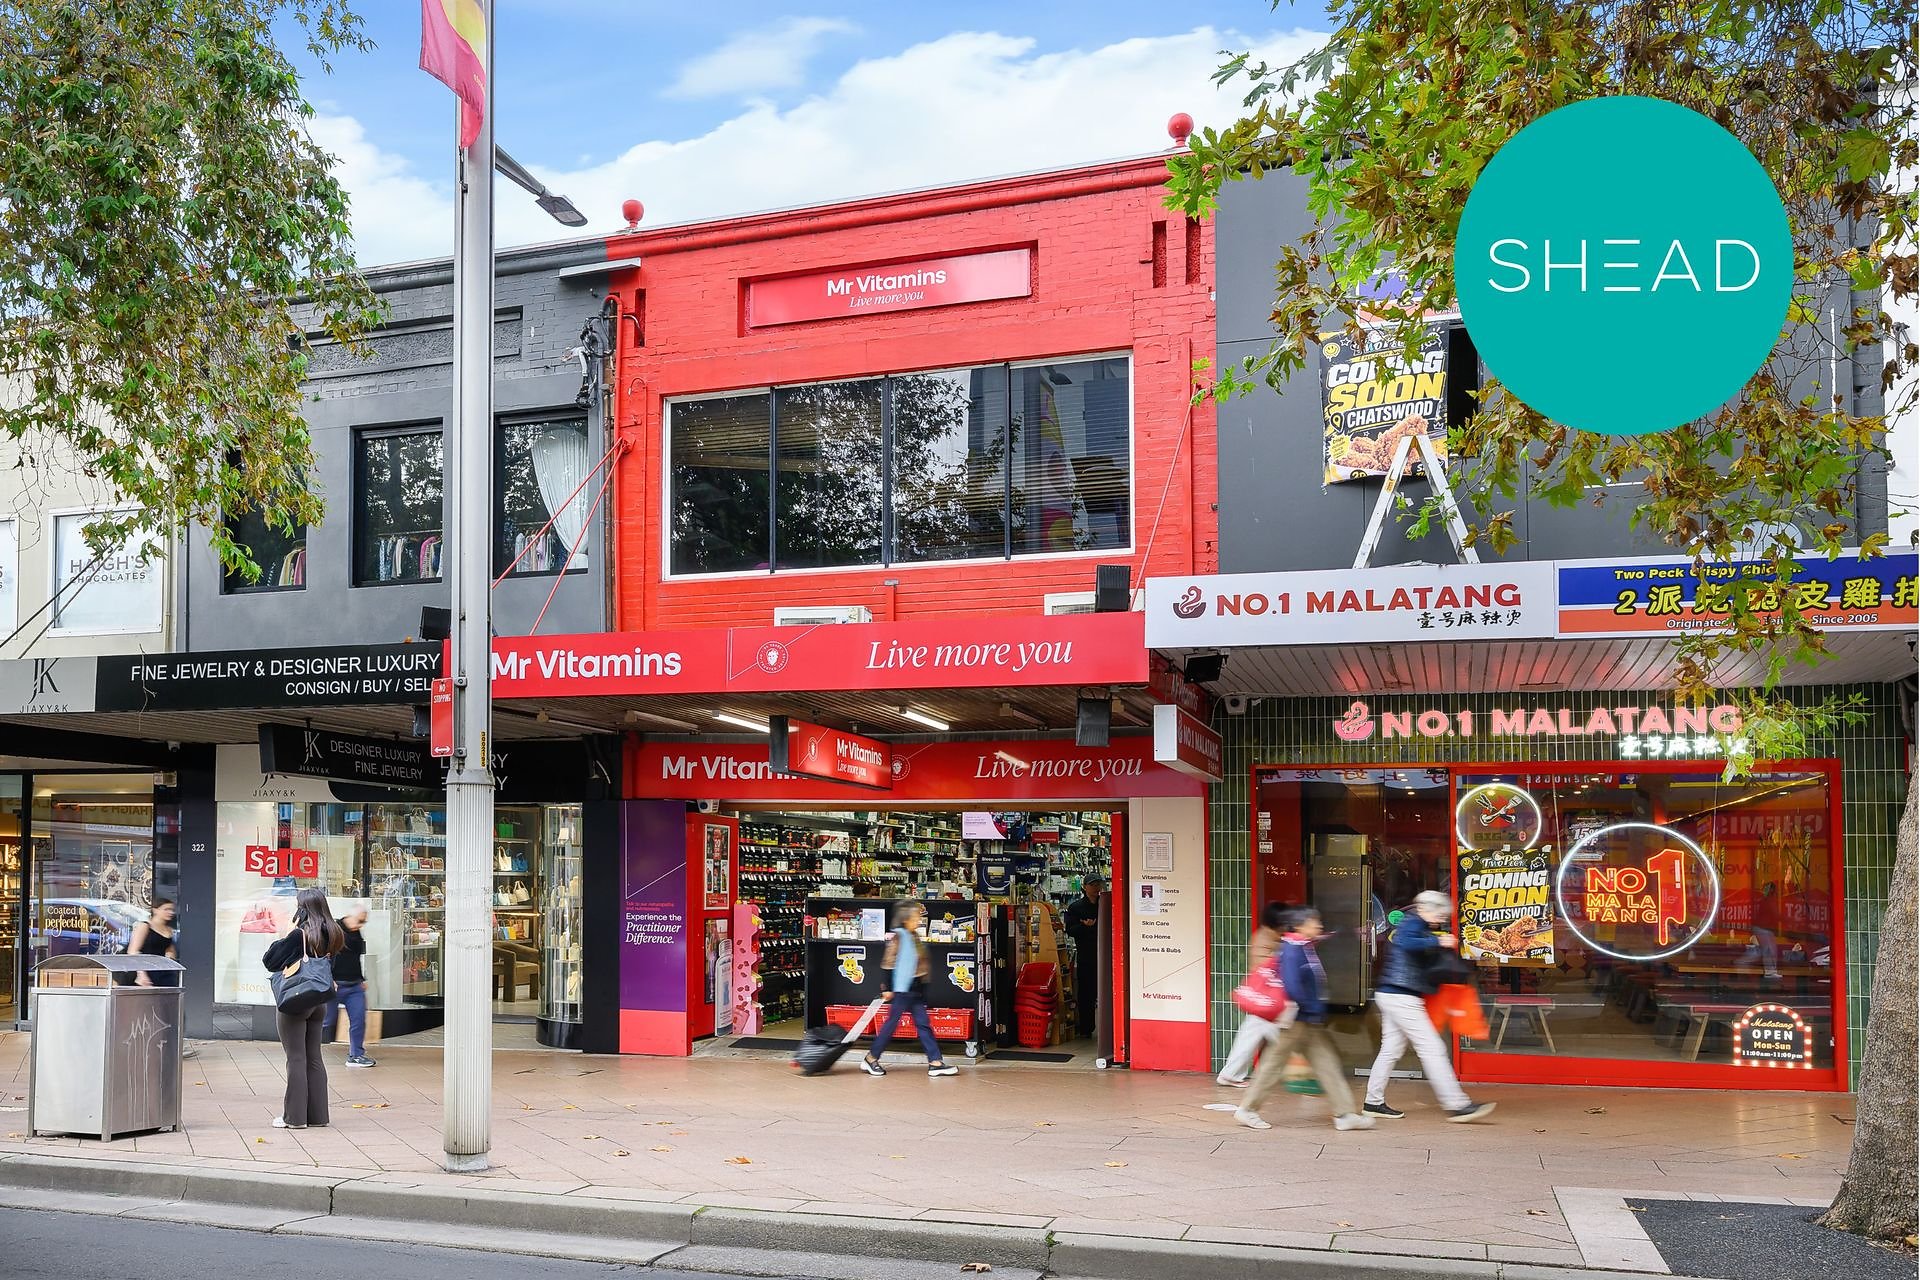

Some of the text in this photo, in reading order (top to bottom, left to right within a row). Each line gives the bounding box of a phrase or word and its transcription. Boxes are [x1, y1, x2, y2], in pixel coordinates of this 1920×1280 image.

[827, 269, 946, 297] Mr Vitamins
[850, 291, 924, 308] Live more you
[1328, 350, 1445, 387] CONG
[1329, 372, 1446, 413] SOON
[1347, 400, 1433, 428] CHATSWOOD
[70, 571, 146, 583] CHOCOLATES
[1615, 570, 1645, 580] Two
[1649, 568, 1684, 579] Peck
[1216, 584, 1521, 616] NO.1 MALATANG
[1812, 614, 1844, 624] Since
[1848, 614, 1878, 623] 2005
[492, 647, 681, 680] Mr Vitamins
[865, 640, 1073, 672] Live more you
[131, 653, 441, 681] FINE JEWELRY & DESIGNER LUXURY
[285, 677, 434, 696] CONSIGN / BUY / SEL
[438, 683, 446, 693] NO
[433, 693, 452, 704] STOPPING
[20, 704, 68, 713] JIAXY&K
[1382, 705, 1743, 738] NO.1 MALATANG
[330, 740, 422, 765] DESIGNER LUXURY
[837, 738, 848, 757] Mr
[849, 740, 883, 767] Vitamins
[355, 761, 423, 780] FINE JEWELRY
[662, 756, 809, 780] Mr Vita
[974, 753, 1143, 782] Live more you
[252, 788, 297, 798] JIAXY&K
[191, 843, 205, 852] 322
[249, 850, 314, 875] Sale
[1464, 870, 1547, 891] COMING
[1587, 867, 1647, 894] NO
[1465, 885, 1549, 910] SOON
[1586, 893, 1657, 909] MA LA
[47, 906, 87, 915] Coated to
[625, 912, 668, 921] Experience
[1479, 906, 1541, 922] CHATSWOOD
[1586, 908, 1659, 924] TANG
[45, 916, 90, 937] perfection
[625, 921, 682, 933] Practitioner
[625, 932, 675, 945] Difference.
[1530, 947, 1545, 956] STAY
[1152, 993, 1182, 1001] Vitamins
[1750, 1018, 1794, 1030] Malatang
[1752, 1029, 1793, 1041] OPEN
[1753, 1041, 1791, 1050] Mon-Sun
[1742, 1050, 1803, 1059] 11:00am-11:00pm
